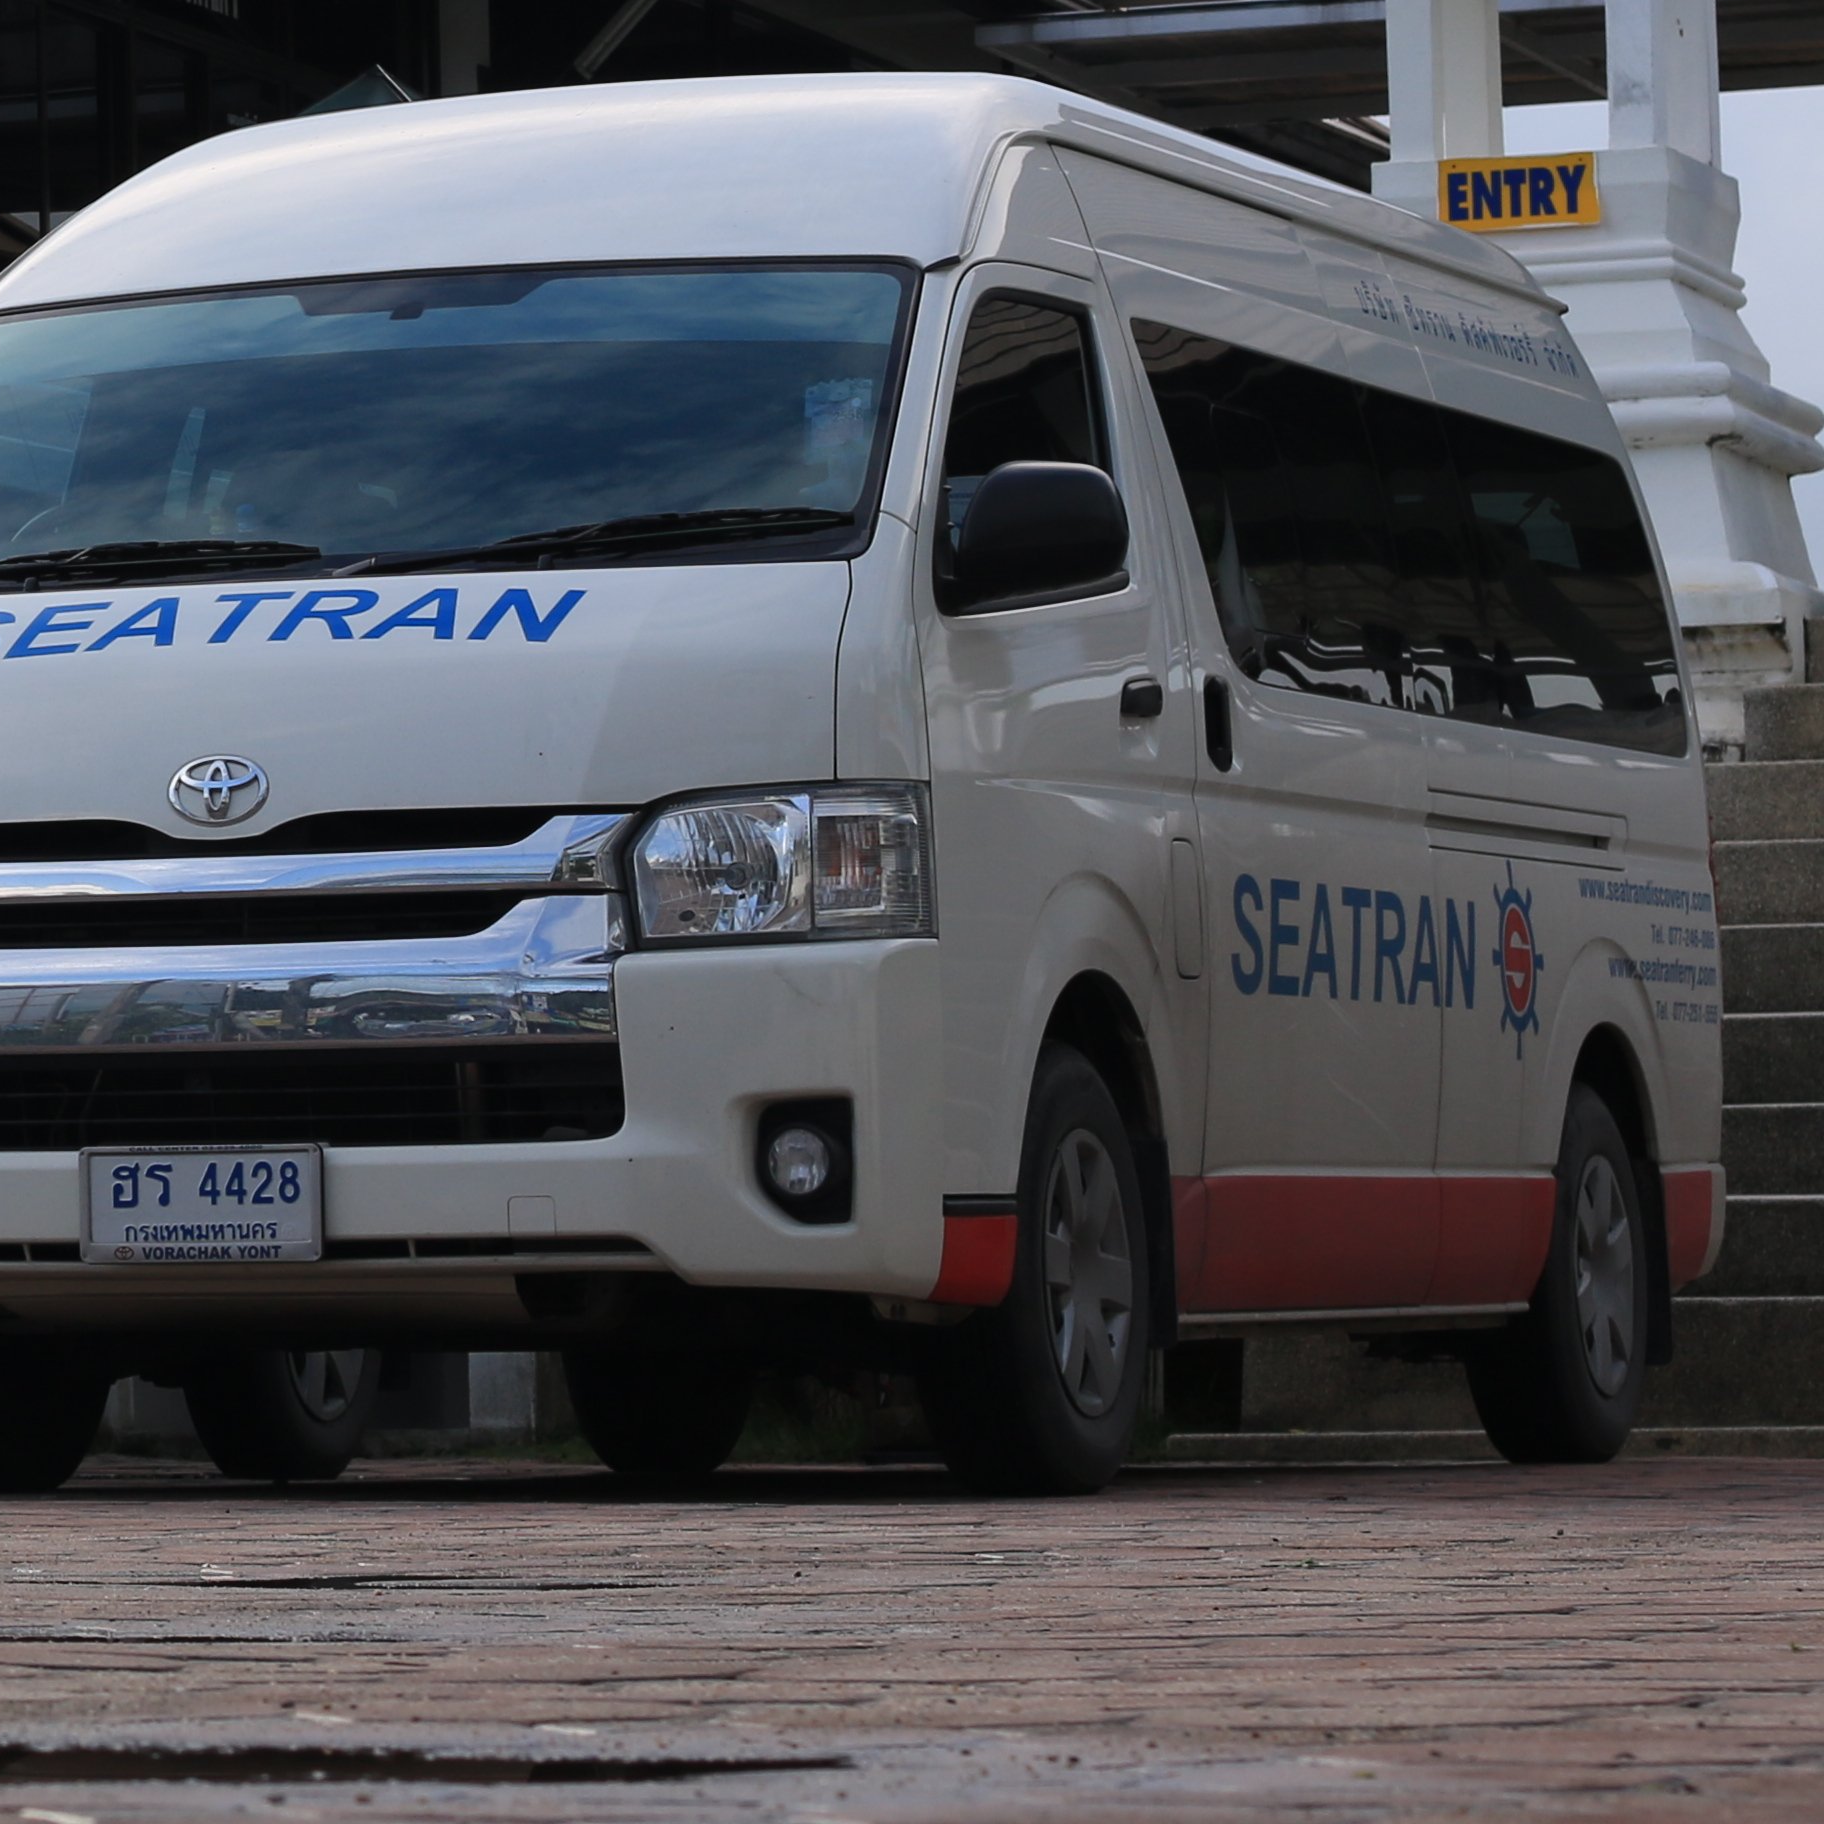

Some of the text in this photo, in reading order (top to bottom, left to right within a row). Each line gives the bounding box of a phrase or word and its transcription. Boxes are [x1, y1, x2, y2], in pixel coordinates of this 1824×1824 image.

[1447, 165, 1586, 221] ENTRY
[1578, 878, 1713, 915] www.seatrandiscovery.com
[1231, 873, 1476, 1009] SEATRAN
[112, 1161, 300, 1209] ฮร 4428
[125, 1222, 278, 1243] กรงเทพมหานคร
[142, 1245, 282, 1260] VORACHAK YONT
